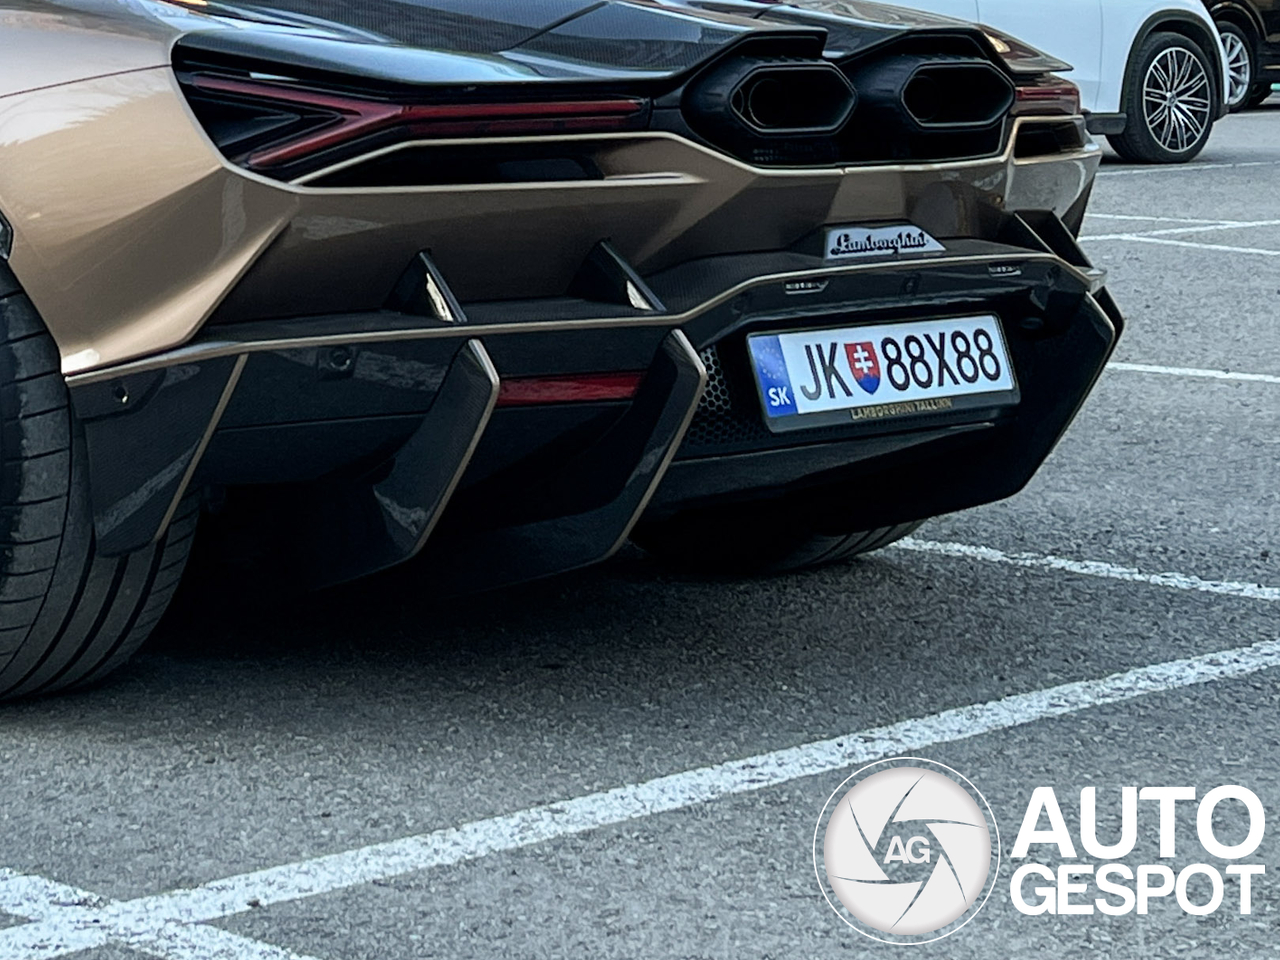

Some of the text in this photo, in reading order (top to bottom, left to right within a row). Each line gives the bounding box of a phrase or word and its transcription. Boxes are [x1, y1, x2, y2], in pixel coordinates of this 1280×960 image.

[830, 230, 930, 255] Lamborghini
[800, 327, 1002, 401] JK 88X88
[769, 387, 791, 407] SK
[850, 397, 953, 420] LAMBORGHINI TALLINN
